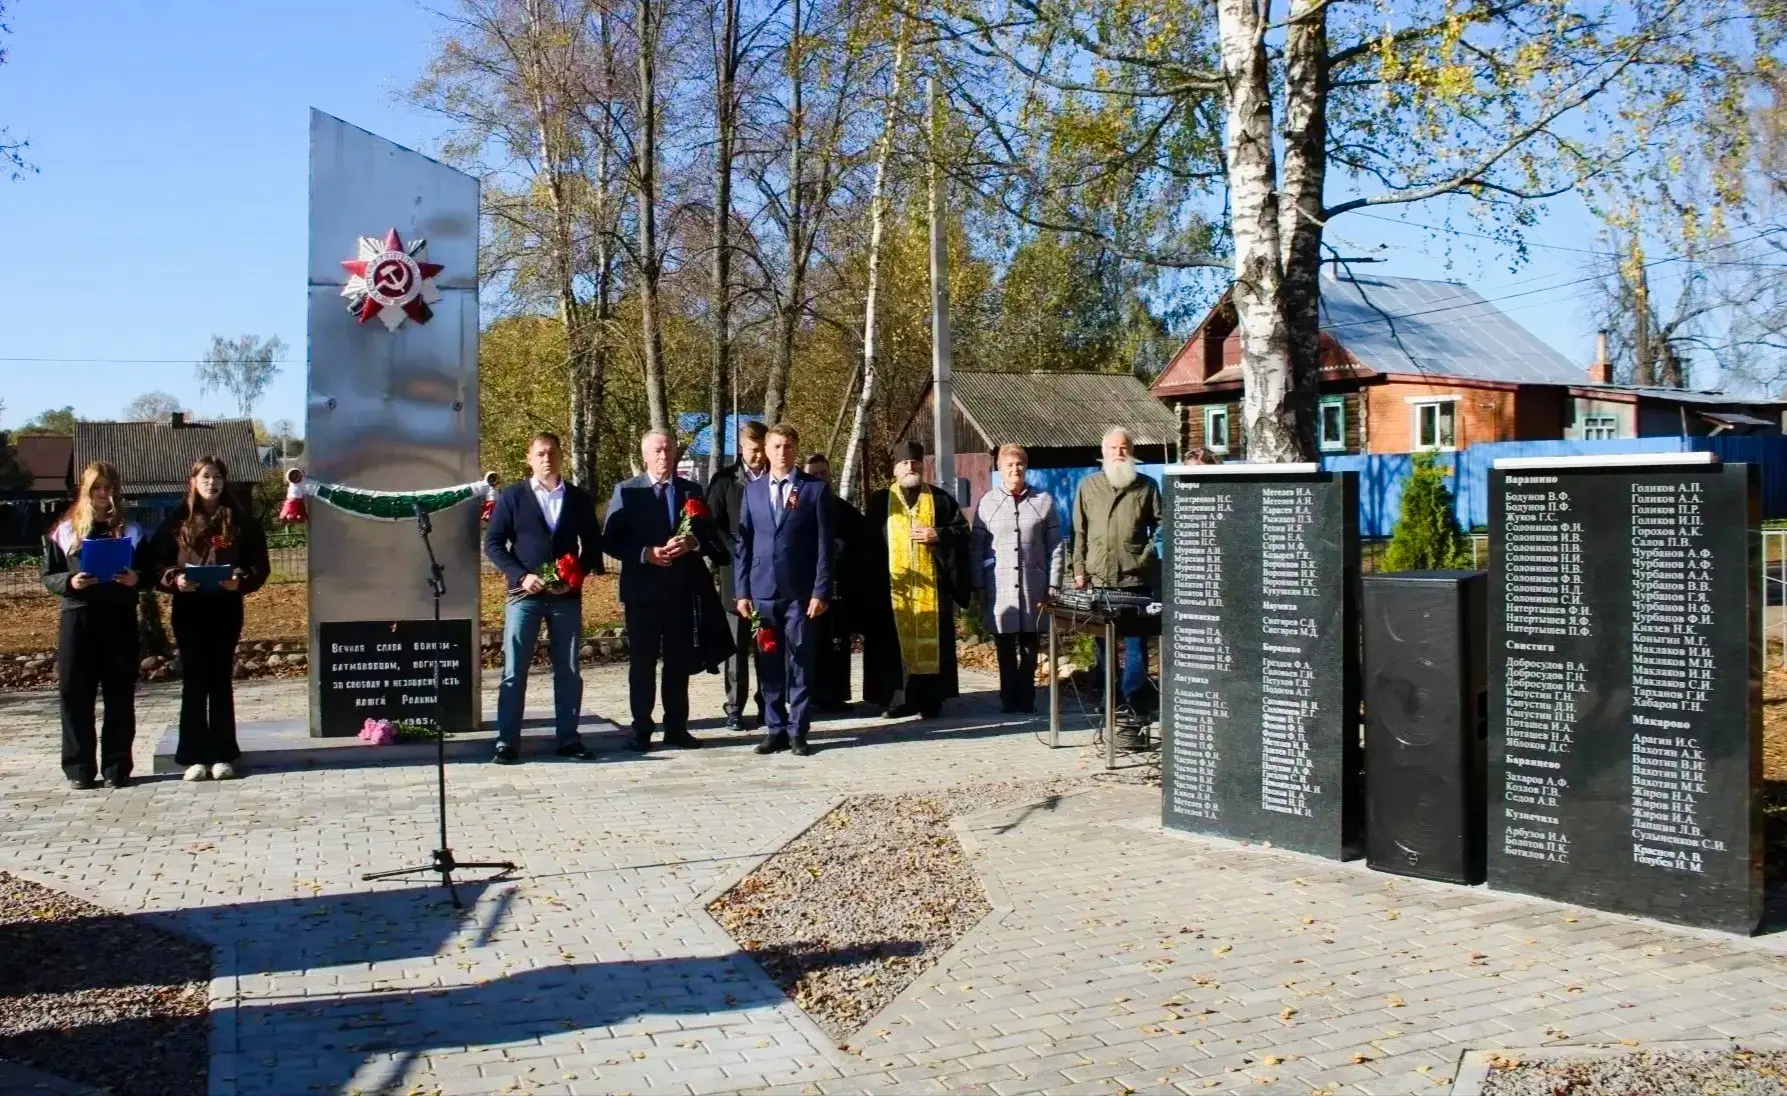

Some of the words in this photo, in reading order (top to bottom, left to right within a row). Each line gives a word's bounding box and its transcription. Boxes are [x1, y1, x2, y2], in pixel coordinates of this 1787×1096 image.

[1632, 484, 1675, 492] Голиков
[1678, 483, 1703, 492] А.П.
[1505, 492, 1545, 503] Бодунов
[1548, 492, 1571, 500] В.Ф.
[1632, 494, 1675, 503] Голиков
[1679, 494, 1703, 503] А.А.
[1505, 502, 1545, 513] Бодунов
[1548, 502, 1571, 511] П.Ф.
[1632, 505, 1675, 513] Голиков
[1679, 505, 1700, 513] П.Р.
[1505, 513, 1536, 523] Жуков
[1539, 513, 1558, 521] Г.С.
[1632, 516, 1675, 524] Голиков
[1632, 526, 1675, 537] Горохов
[1678, 527, 1703, 536] А.К.
[1632, 537, 1664, 546] Салов
[1668, 538, 1692, 546] П.В.
[1561, 544, 1582, 552] П.В.
[1632, 548, 1684, 559] Чурбанов
[1688, 549, 1714, 558] А.Ф.
[1632, 558, 1684, 570] Чурбанов
[1687, 560, 1714, 569] А.Ф.
[1632, 569, 1684, 580] Чурбанов
[1688, 571, 1713, 580] А.А.
[1632, 580, 1684, 591] Чурбанов
[1688, 582, 1712, 591] В.В.
[1632, 591, 1684, 602] Чурбанов
[1688, 593, 1710, 602] Г.Я.
[1632, 601, 1684, 612] Чурбанов
[1569, 617, 1592, 626] Я.Ф.
[1632, 612, 1684, 623] Чурбанов
[1568, 626, 1592, 636] П.Ф.
[1633, 622, 1670, 633] Князев
[1684, 636, 1708, 646] М.Г.
[1506, 657, 1563, 670] Добросудов
[1566, 662, 1588, 671] В.А.
[1506, 677, 1563, 690] Добросудов
[1632, 686, 1683, 699] Тарханов
[1632, 697, 1678, 710] Хабаров
[1506, 708, 1552, 719] Капустин
[1506, 718, 1548, 729] Поташев
[1632, 715, 1690, 729] Макарово
[1506, 728, 1548, 739] Поташев
[1632, 733, 1671, 745] Арагин
[1506, 738, 1546, 749] Яблоков
[1548, 742, 1570, 753] Д.С.
[1633, 744, 1677, 757] Вахотин
[1681, 749, 1705, 760] А.К.
[1633, 754, 1677, 767] Вахотин
[1506, 772, 1543, 784] Захаров
[1546, 777, 1570, 787] А.Ф.
[1633, 775, 1677, 789] Вахотин
[1681, 782, 1708, 793] М.К.
[1506, 782, 1539, 794] Козлов
[1542, 786, 1561, 797] Г.В.
[1632, 786, 1668, 799] Жиров
[1506, 792, 1535, 803] Седов
[1537, 796, 1559, 807] А.В.
[1632, 808, 1668, 821] Жиров
[1506, 826, 1545, 839] Арбузов
